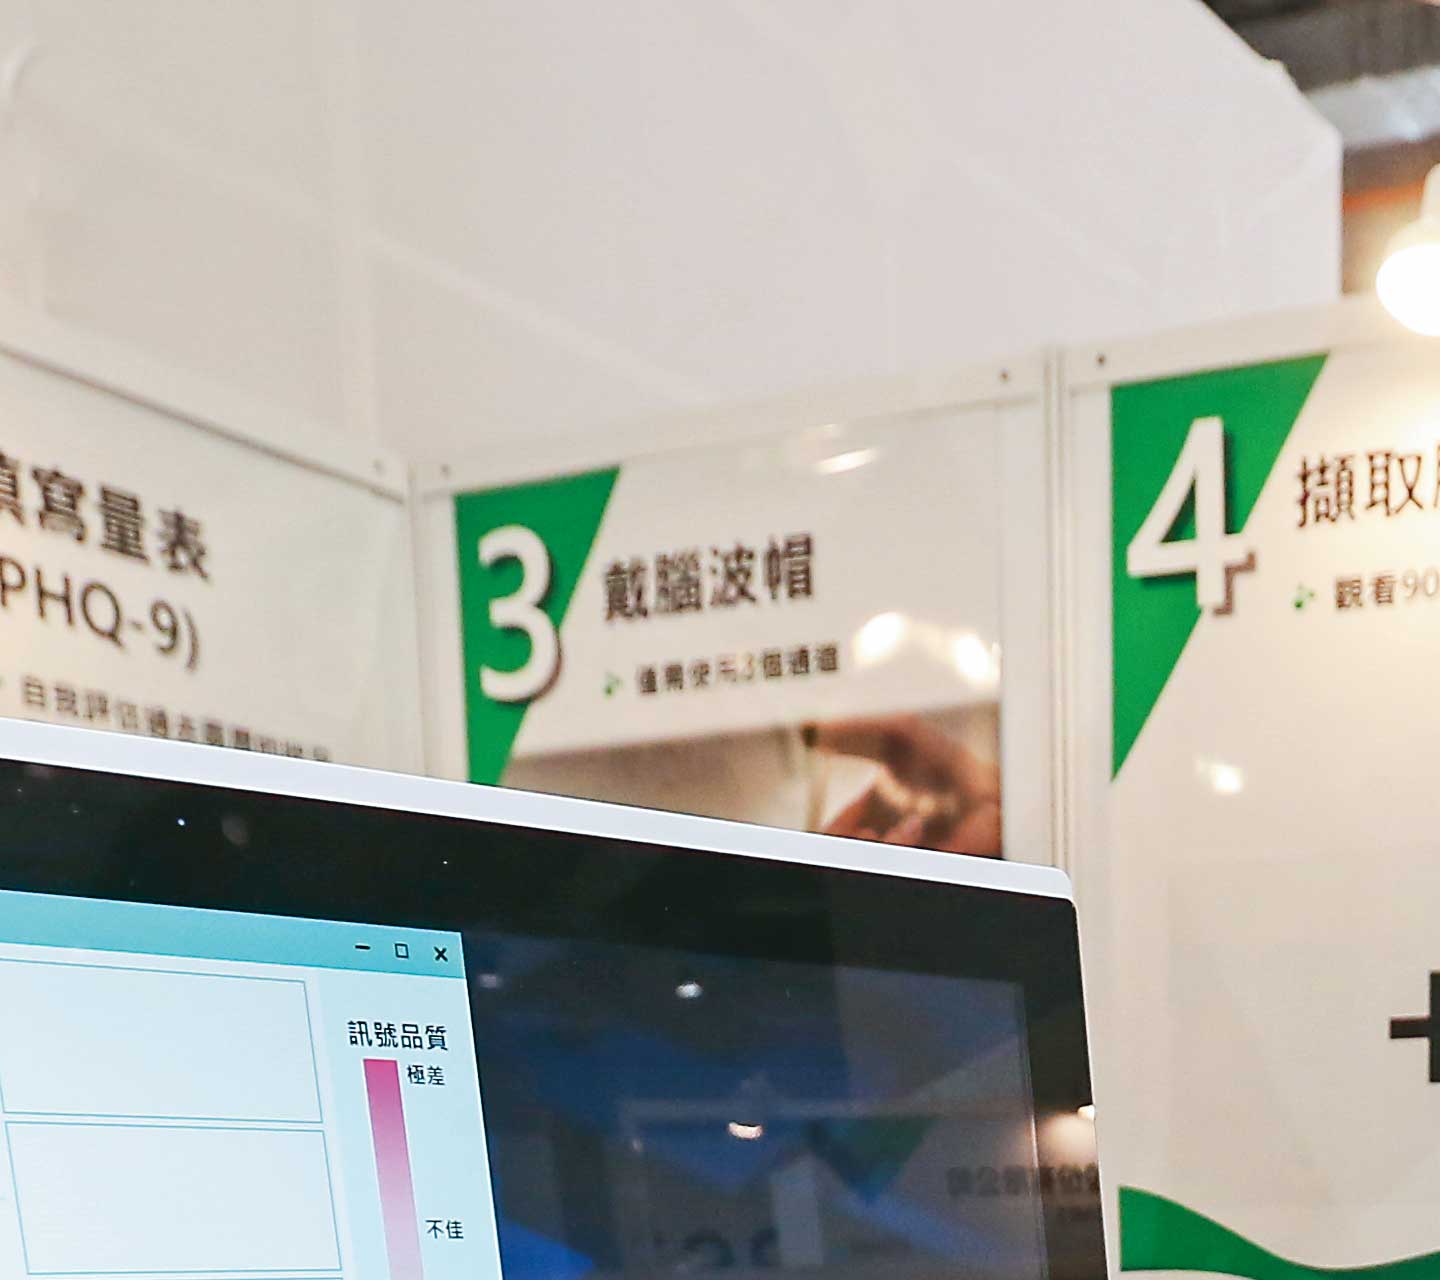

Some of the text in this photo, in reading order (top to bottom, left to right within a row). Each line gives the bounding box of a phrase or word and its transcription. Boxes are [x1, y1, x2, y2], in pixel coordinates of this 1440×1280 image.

[1126, 415, 1250, 612] 4
[603, 532, 814, 622] 戴腦波帽
[477, 523, 560, 702] 3
[347, 1018, 449, 1053] 訊號品質
[406, 1063, 446, 1087] 極差
[425, 1219, 464, 1242] 不佳
